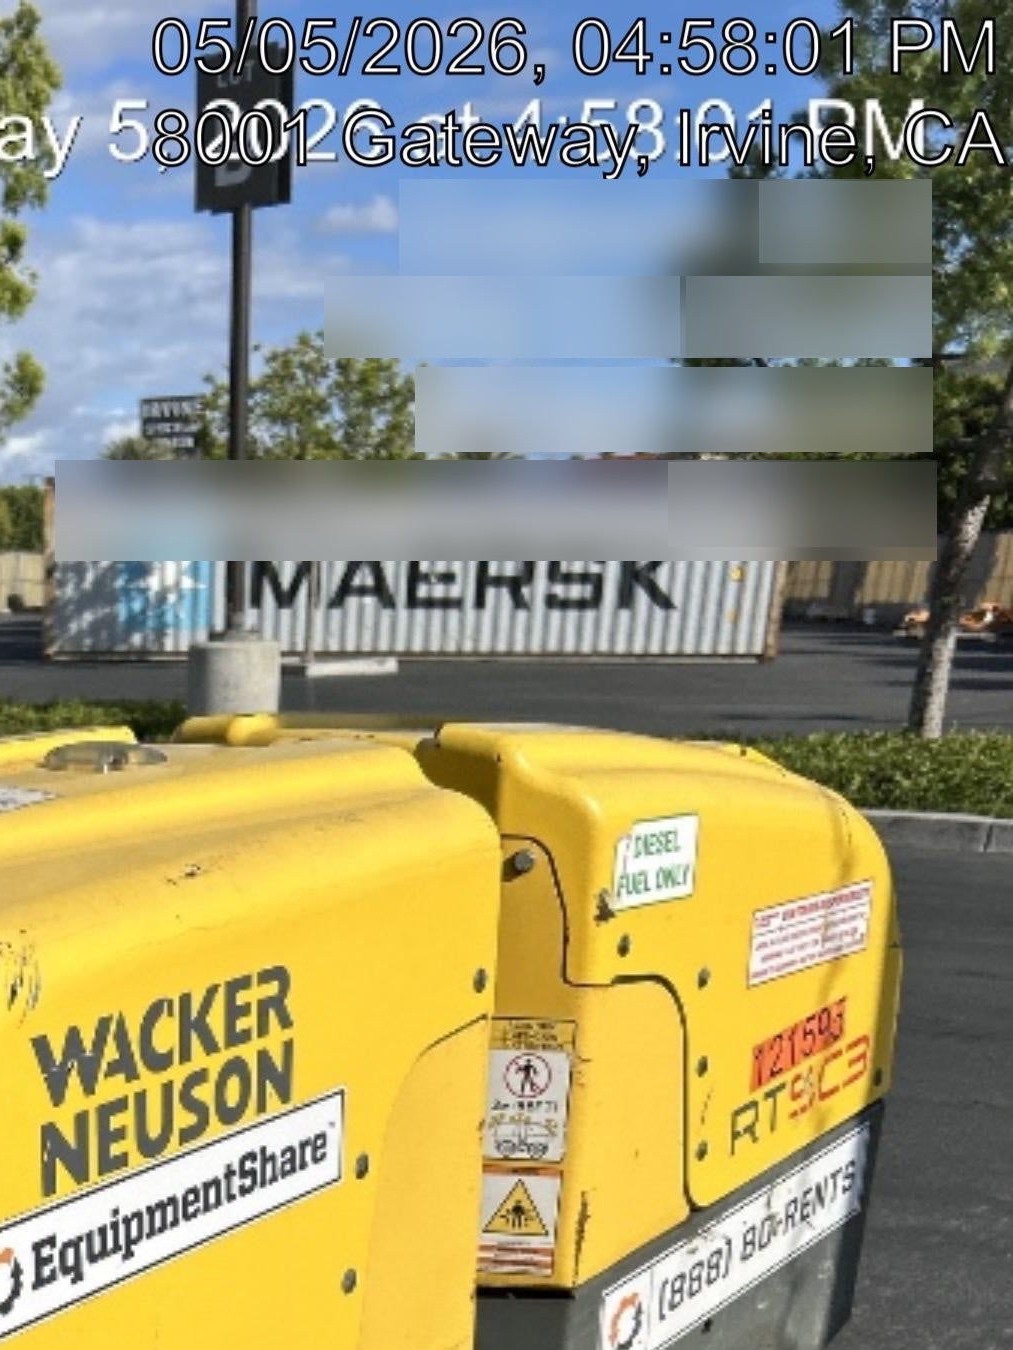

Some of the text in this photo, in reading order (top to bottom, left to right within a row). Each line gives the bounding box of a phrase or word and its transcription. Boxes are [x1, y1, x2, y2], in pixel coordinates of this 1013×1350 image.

[251, 561, 677, 610] MAERSK
[616, 863, 690, 899] FUEL ONLY
[634, 829, 681, 858] DIESEL
[30, 965, 294, 1107] WACKER
[40, 1039, 294, 1197] NEUSON
[31, 1131, 329, 1292] EquipmentShare
[659, 1240, 733, 1321] (888)
